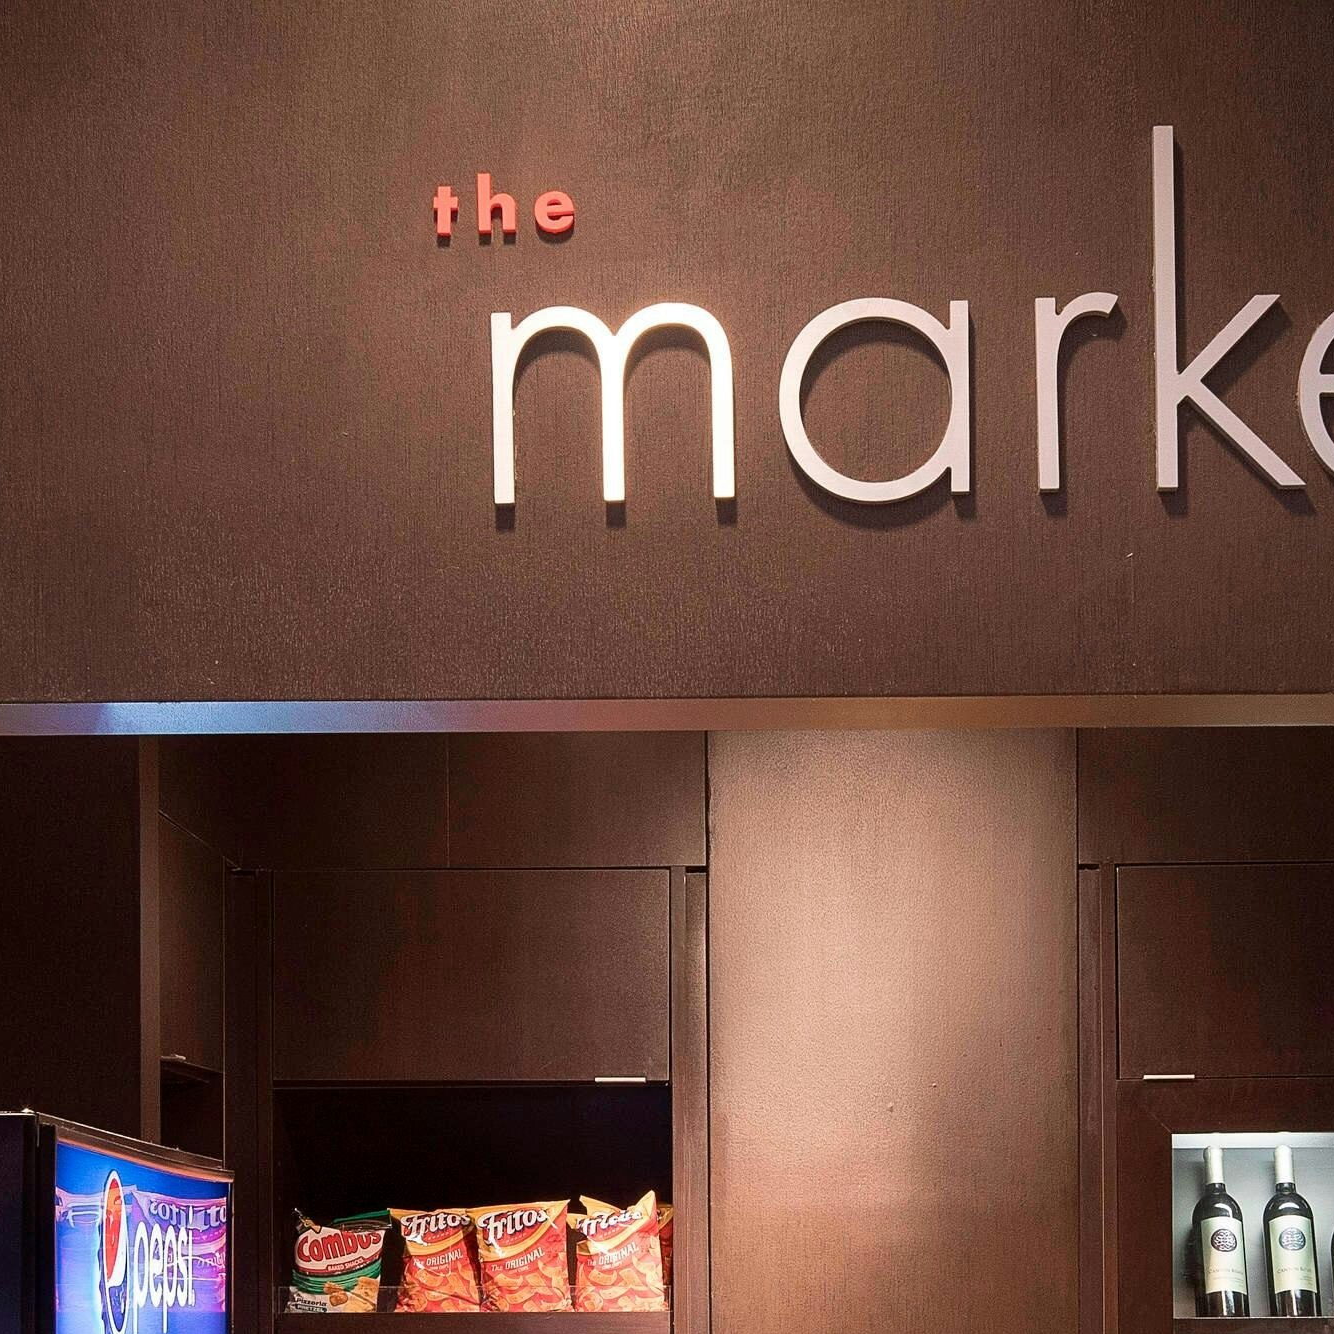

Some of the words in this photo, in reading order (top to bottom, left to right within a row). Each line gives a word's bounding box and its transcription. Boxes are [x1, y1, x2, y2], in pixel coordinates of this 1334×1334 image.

[433, 172, 575, 237] the
[400, 1212, 471, 1246] Fritos
[477, 1208, 549, 1246] Fritos
[426, 1249, 464, 1267] ORIGINAL
[505, 1246, 546, 1270] ORIGINAL
